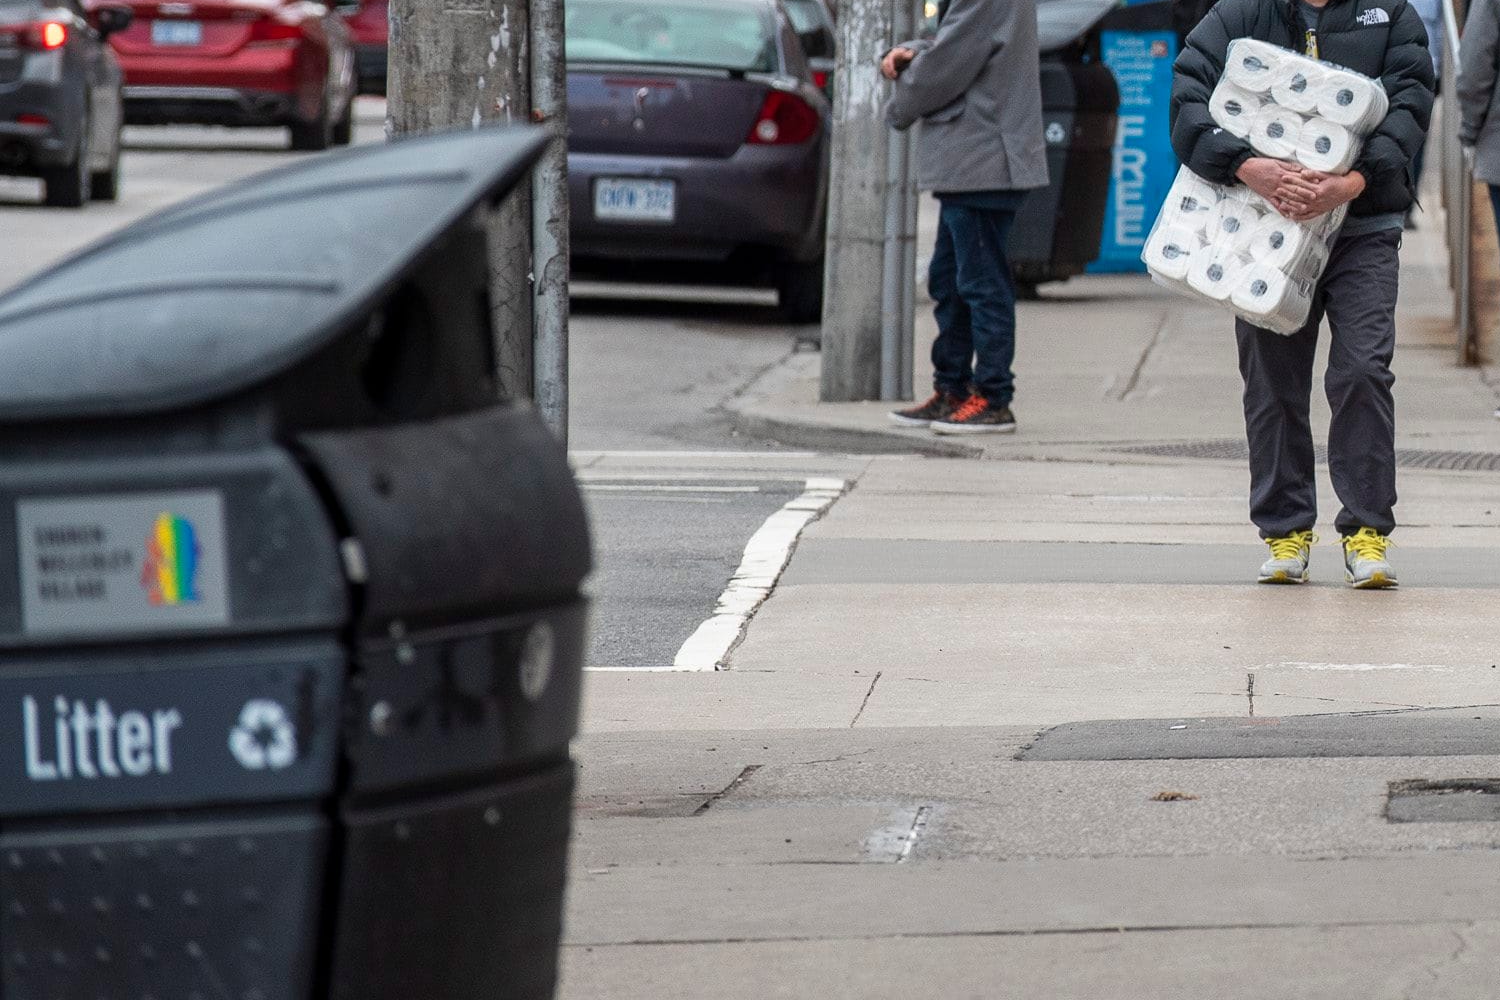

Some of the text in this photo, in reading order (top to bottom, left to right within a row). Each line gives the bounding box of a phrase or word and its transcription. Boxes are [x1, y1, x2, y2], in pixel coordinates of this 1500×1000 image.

[1356, 14, 1377, 22] NORTH
[1112, 115, 1147, 246] FREE
[23, 694, 184, 781] Litter
